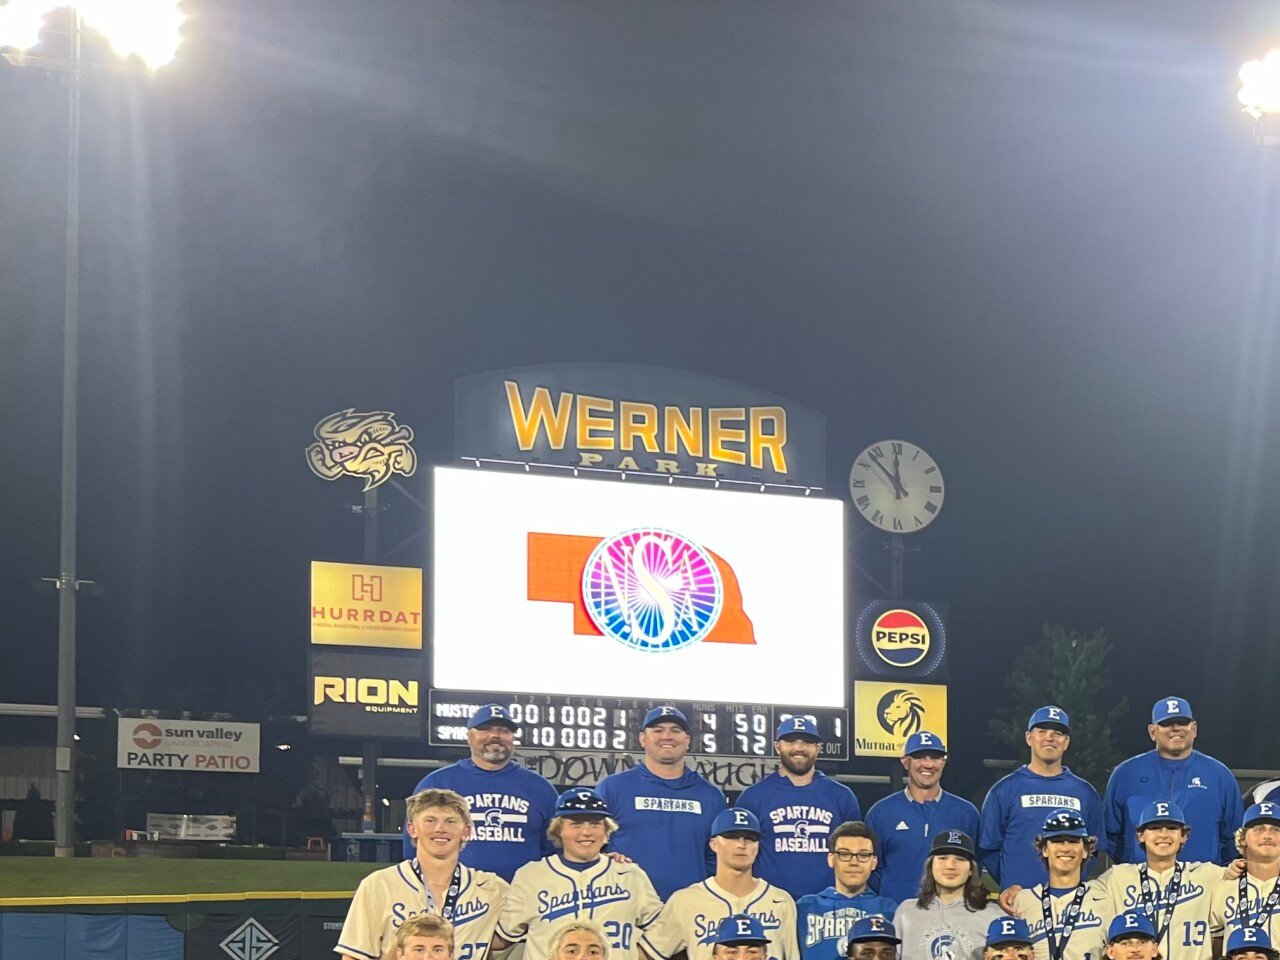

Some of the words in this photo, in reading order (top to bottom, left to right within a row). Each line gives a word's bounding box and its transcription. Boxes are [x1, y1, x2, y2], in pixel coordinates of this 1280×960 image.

[504, 380, 788, 474] WERNER
[579, 452, 718, 477] PARK
[312, 606, 421, 625] HURRDAT
[876, 630, 926, 645] PEPSI
[314, 676, 419, 706] RION
[365, 706, 419, 714] EQUIPMENT
[490, 705, 504, 718] E
[1049, 708, 1061, 720] E
[1167, 700, 1180, 714] E
[793, 718, 806, 730] E
[165, 728, 194, 738] sun
[197, 728, 242, 742] valley
[920, 733, 933, 745] E
[827, 743, 841, 755] OUT
[127, 751, 189, 767] PARTY
[195, 754, 251, 770] PATIO
[464, 793, 530, 814] PARTANS
[643, 798, 694, 811] SPARTANS
[1028, 794, 1075, 808] SPARTANS
[769, 804, 833, 826] SPARTANS
[1157, 803, 1170, 816] E
[1260, 803, 1273, 815] E
[734, 811, 749, 825] E
[467, 826, 526, 843] ASEBALL
[947, 831, 962, 844] E
[775, 836, 829, 854] BASEBALL
[736, 919, 752, 935] E
[870, 918, 885, 932] E
[1001, 920, 1016, 935] E
[1125, 914, 1139, 927] E
[603, 920, 633, 950] 20
[806, 912, 867, 947] SPART
[1182, 920, 1207, 947] 13
[1243, 928, 1257, 941] E
